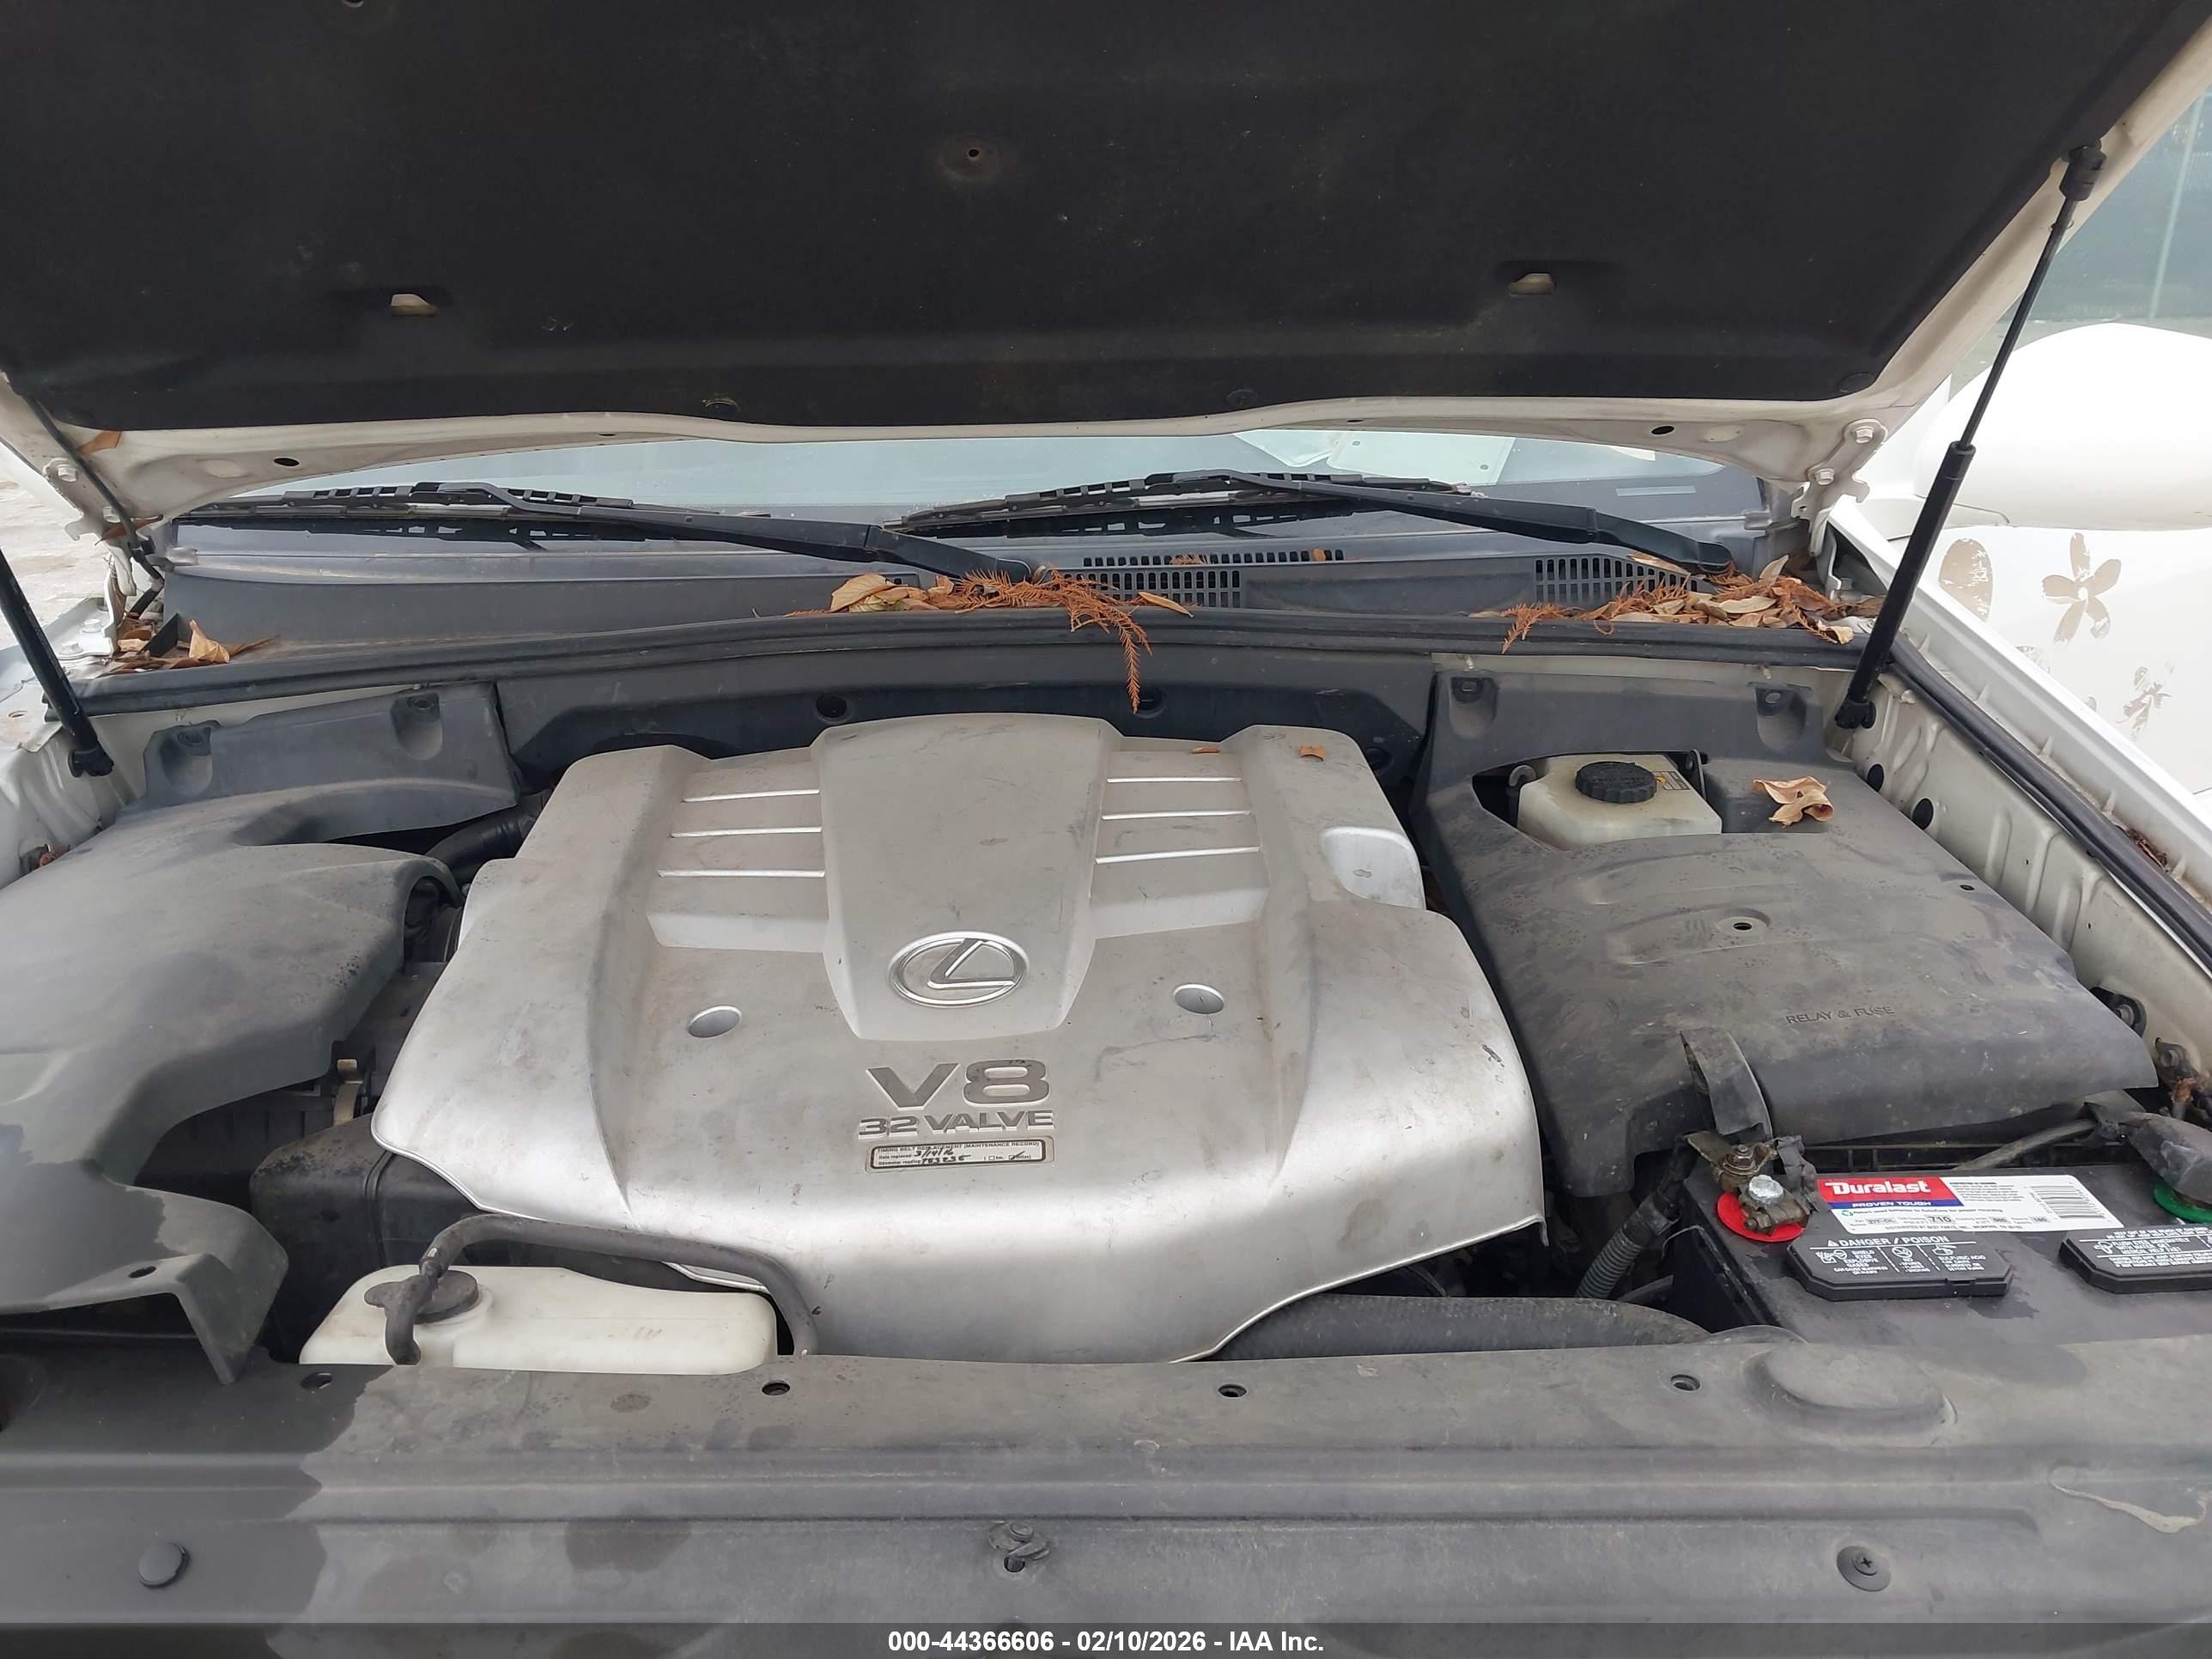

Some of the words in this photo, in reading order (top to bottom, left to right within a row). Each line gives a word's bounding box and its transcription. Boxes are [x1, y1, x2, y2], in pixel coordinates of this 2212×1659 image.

[1785, 1012, 1832, 1024] RELAY
[1838, 1010, 1851, 1018] &
[1854, 1006, 1895, 1017] FUSE
[866, 1059, 1050, 1111] V8
[859, 1115, 918, 1139] 32
[924, 1110, 1054, 1134] VALVE
[1825, 1180, 1931, 1196] Duralast
[1838, 1238, 1891, 1247] DANGER
